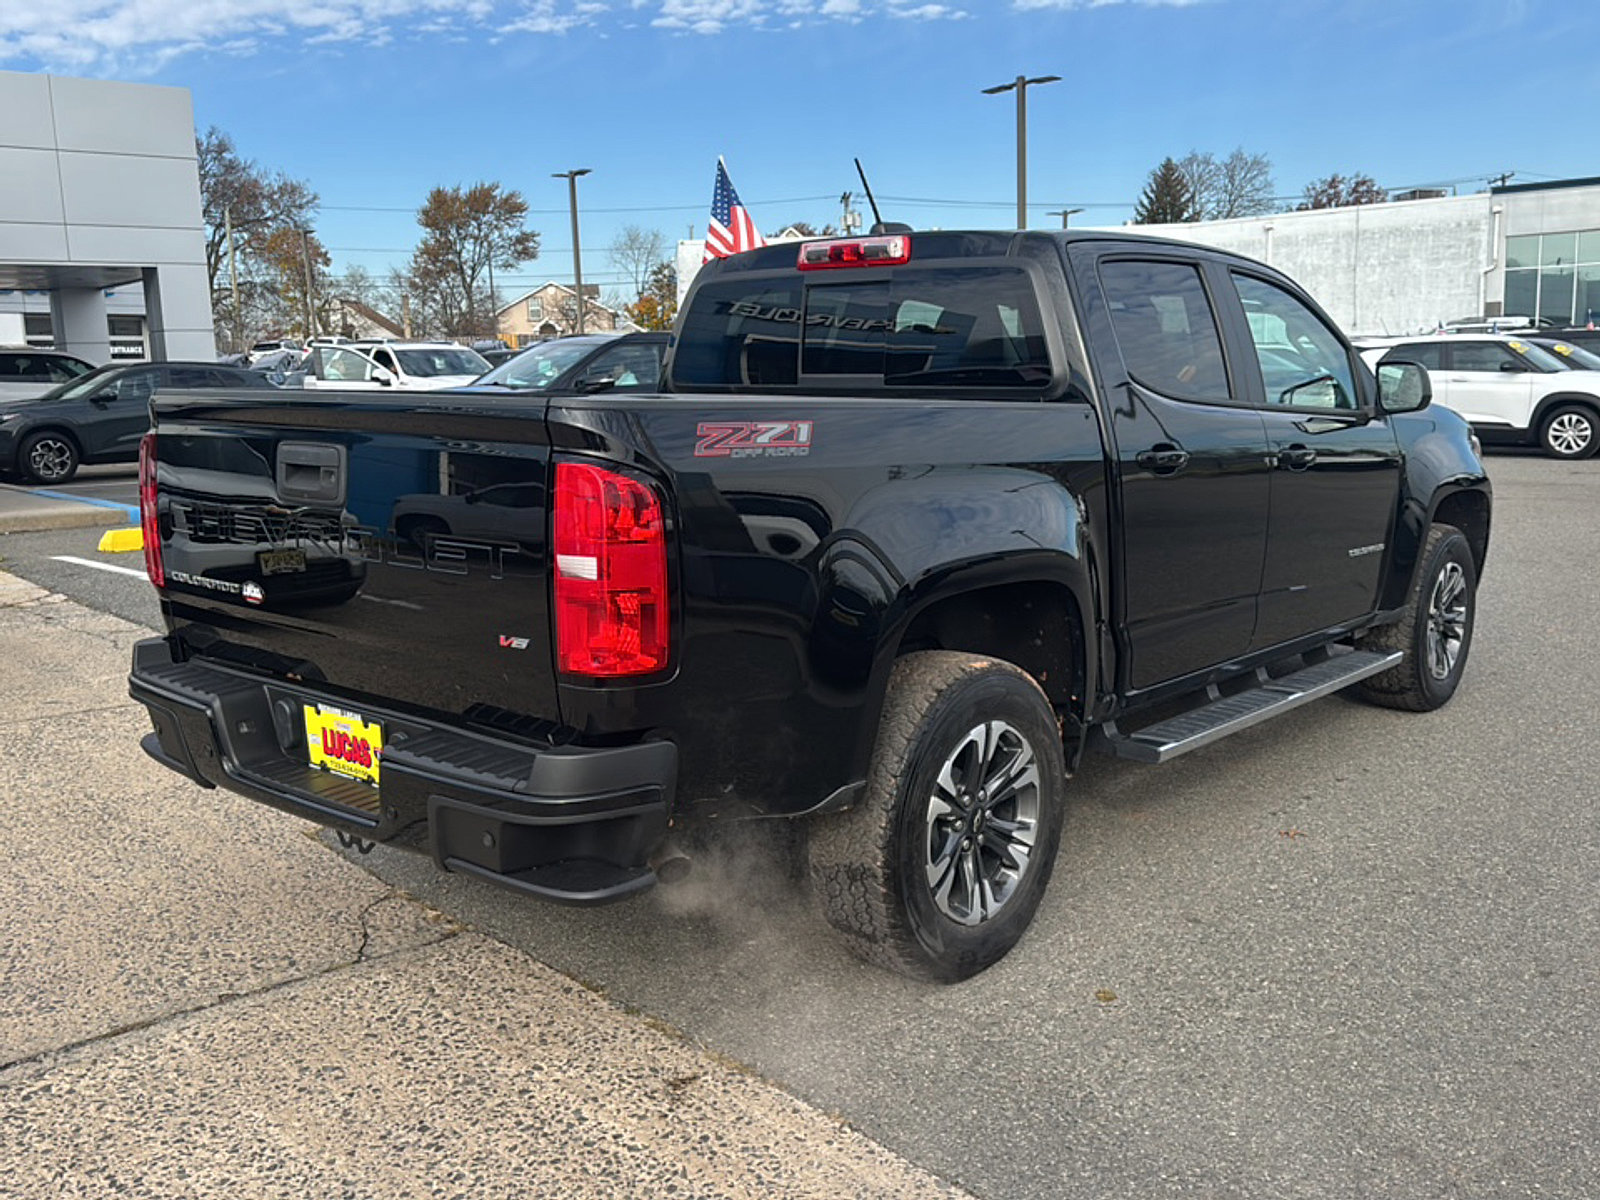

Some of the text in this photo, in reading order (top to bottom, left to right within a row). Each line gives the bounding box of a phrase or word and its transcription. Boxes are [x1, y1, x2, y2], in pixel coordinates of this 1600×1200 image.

[694, 420, 814, 457] Z71
[731, 446, 810, 458] OFF ROAD
[171, 571, 241, 594] COLORADO
[499, 634, 530, 650] V6
[321, 726, 373, 769] LUCAS
